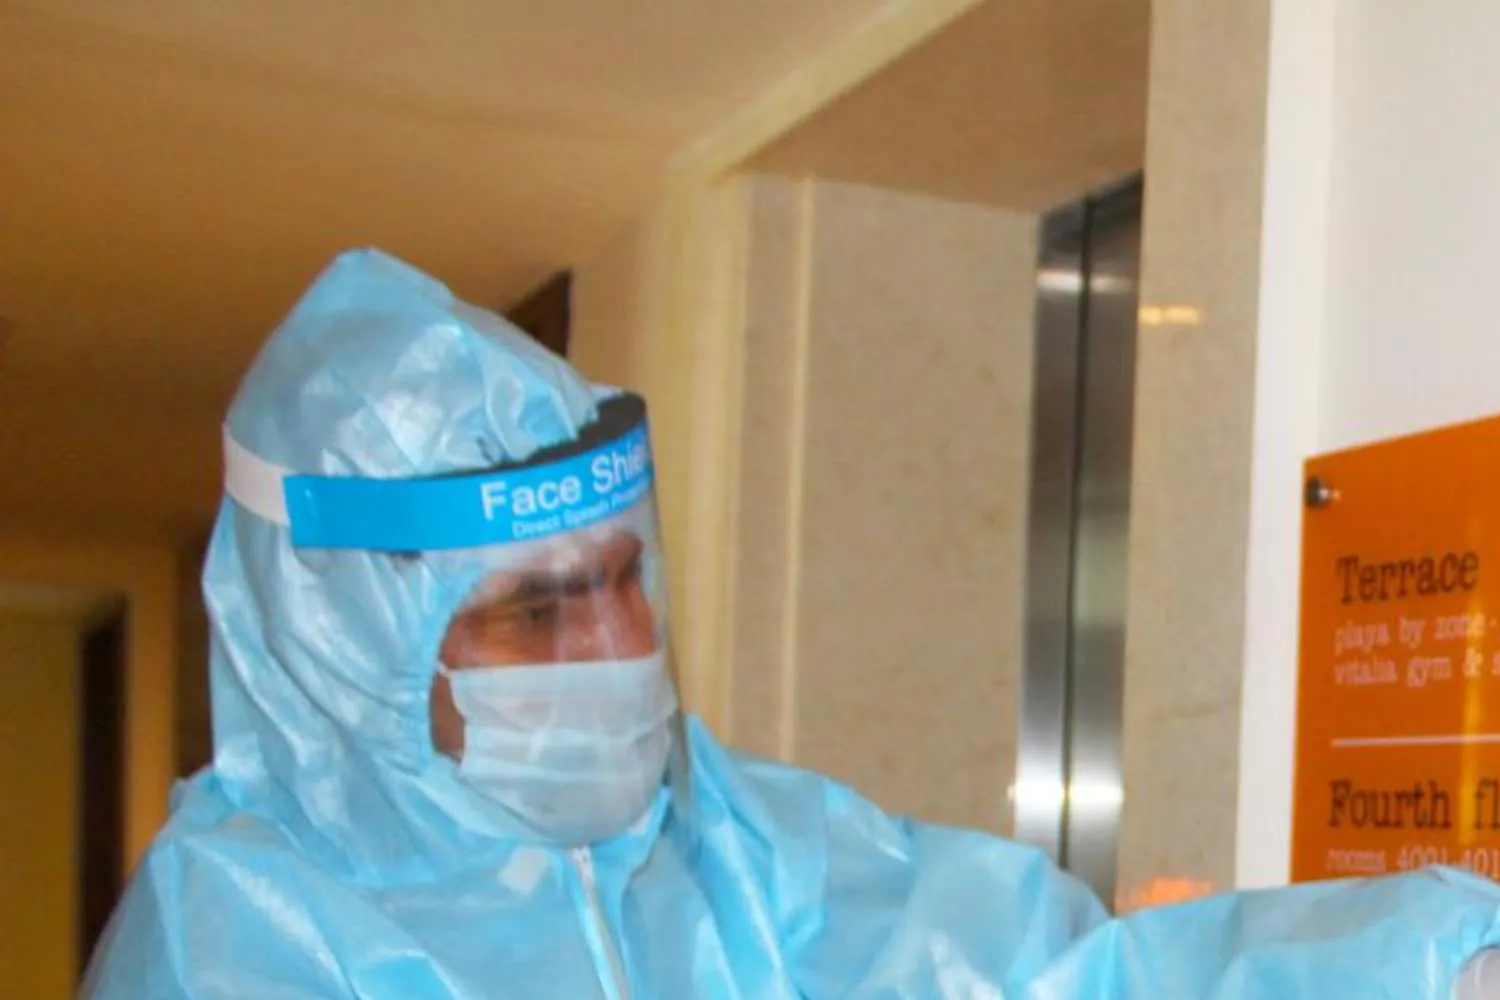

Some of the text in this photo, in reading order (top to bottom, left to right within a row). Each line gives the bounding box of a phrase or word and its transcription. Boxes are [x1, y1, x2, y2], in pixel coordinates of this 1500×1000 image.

[480, 475, 582, 522] Face
[1335, 551, 1480, 606] Terrace
[1400, 615, 1425, 649] by
[1407, 656, 1452, 688] gym
[1462, 646, 1483, 678] &
[1328, 778, 1452, 830] Fourth
[1326, 849, 1386, 875] rooms
